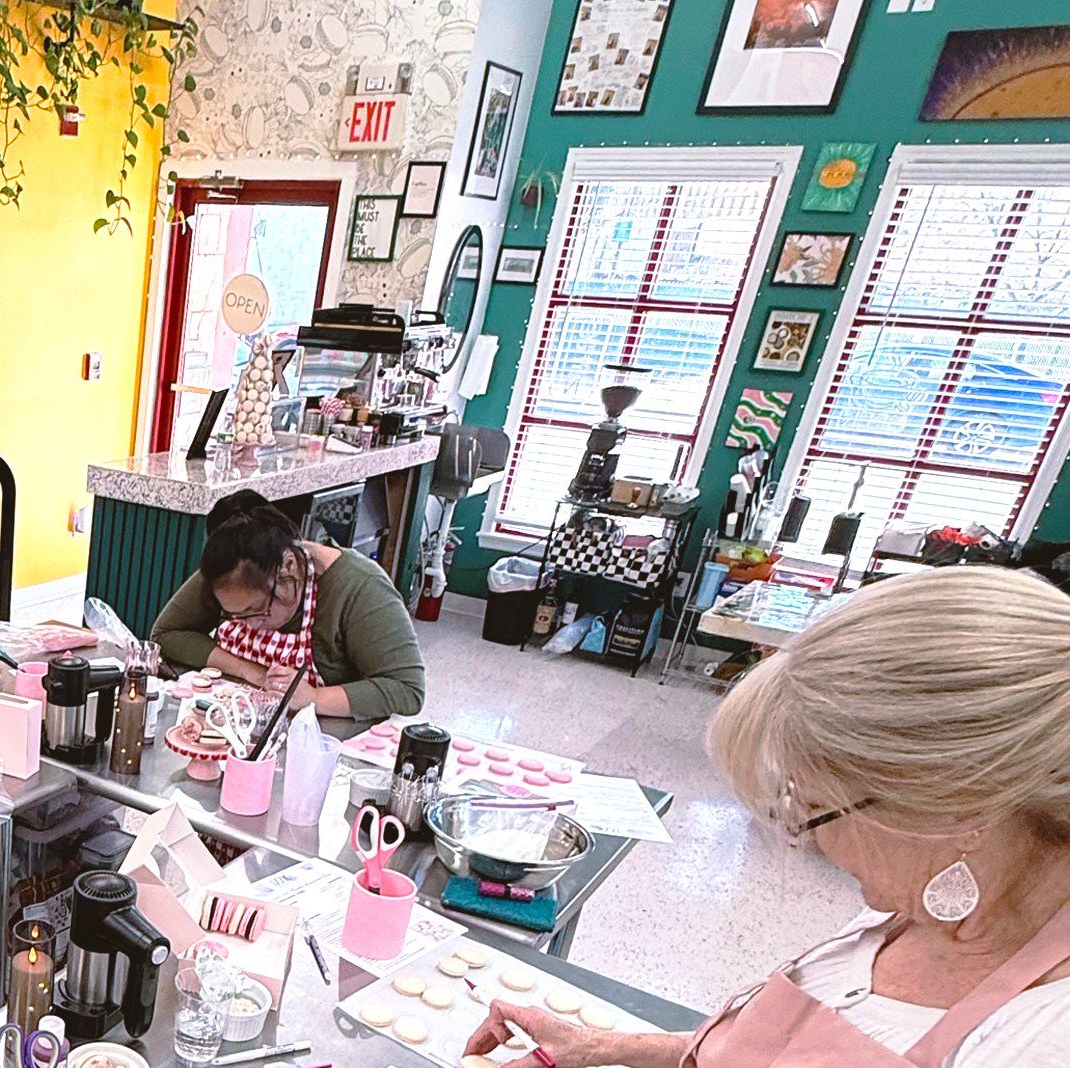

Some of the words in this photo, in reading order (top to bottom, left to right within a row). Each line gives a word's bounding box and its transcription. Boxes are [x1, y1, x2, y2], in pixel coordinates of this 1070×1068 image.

[349, 101, 396, 142] EXIT
[359, 200, 376, 210] THIS
[357, 211, 380, 222] MUST
[355, 223, 364, 234] BE
[353, 235, 367, 246] THE
[352, 247, 376, 258] PLACE
[225, 292, 266, 318] OPEN
